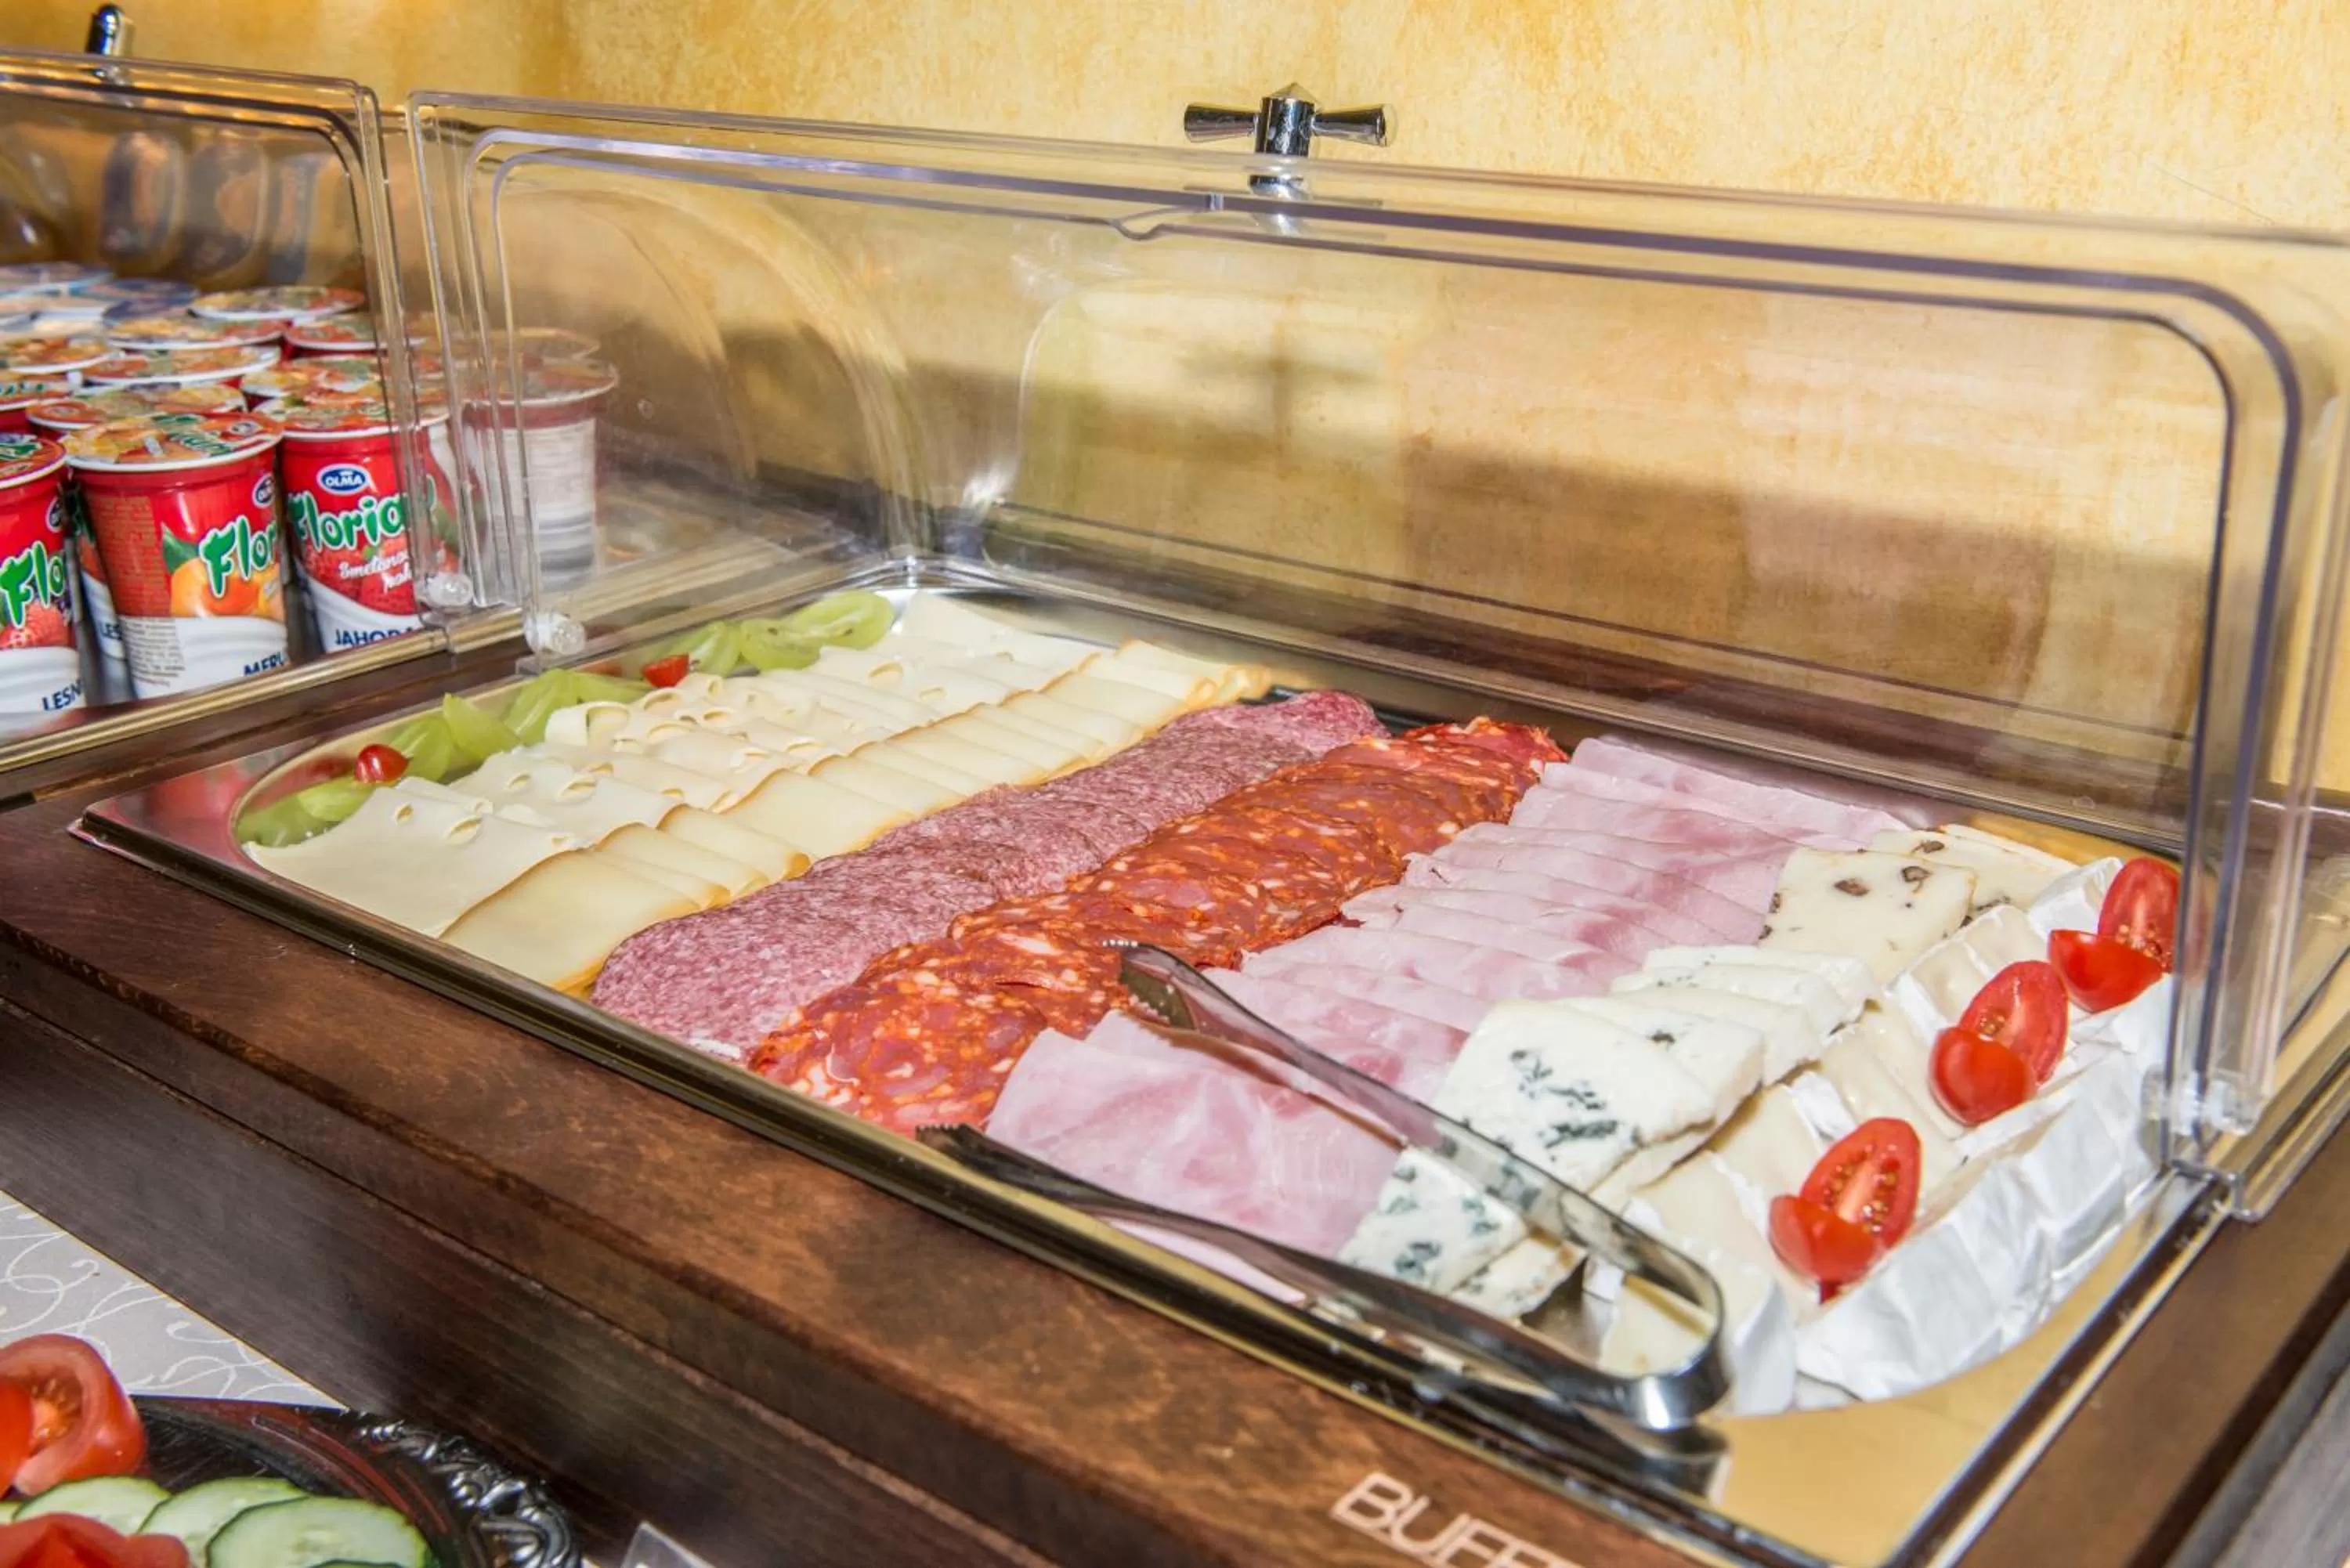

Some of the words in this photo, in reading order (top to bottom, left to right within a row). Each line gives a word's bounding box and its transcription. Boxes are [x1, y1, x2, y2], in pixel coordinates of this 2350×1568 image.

[324, 475, 363, 488] OLMA
[335, 627, 413, 646] JAHO
[1330, 1471, 1584, 1568] BUFF
